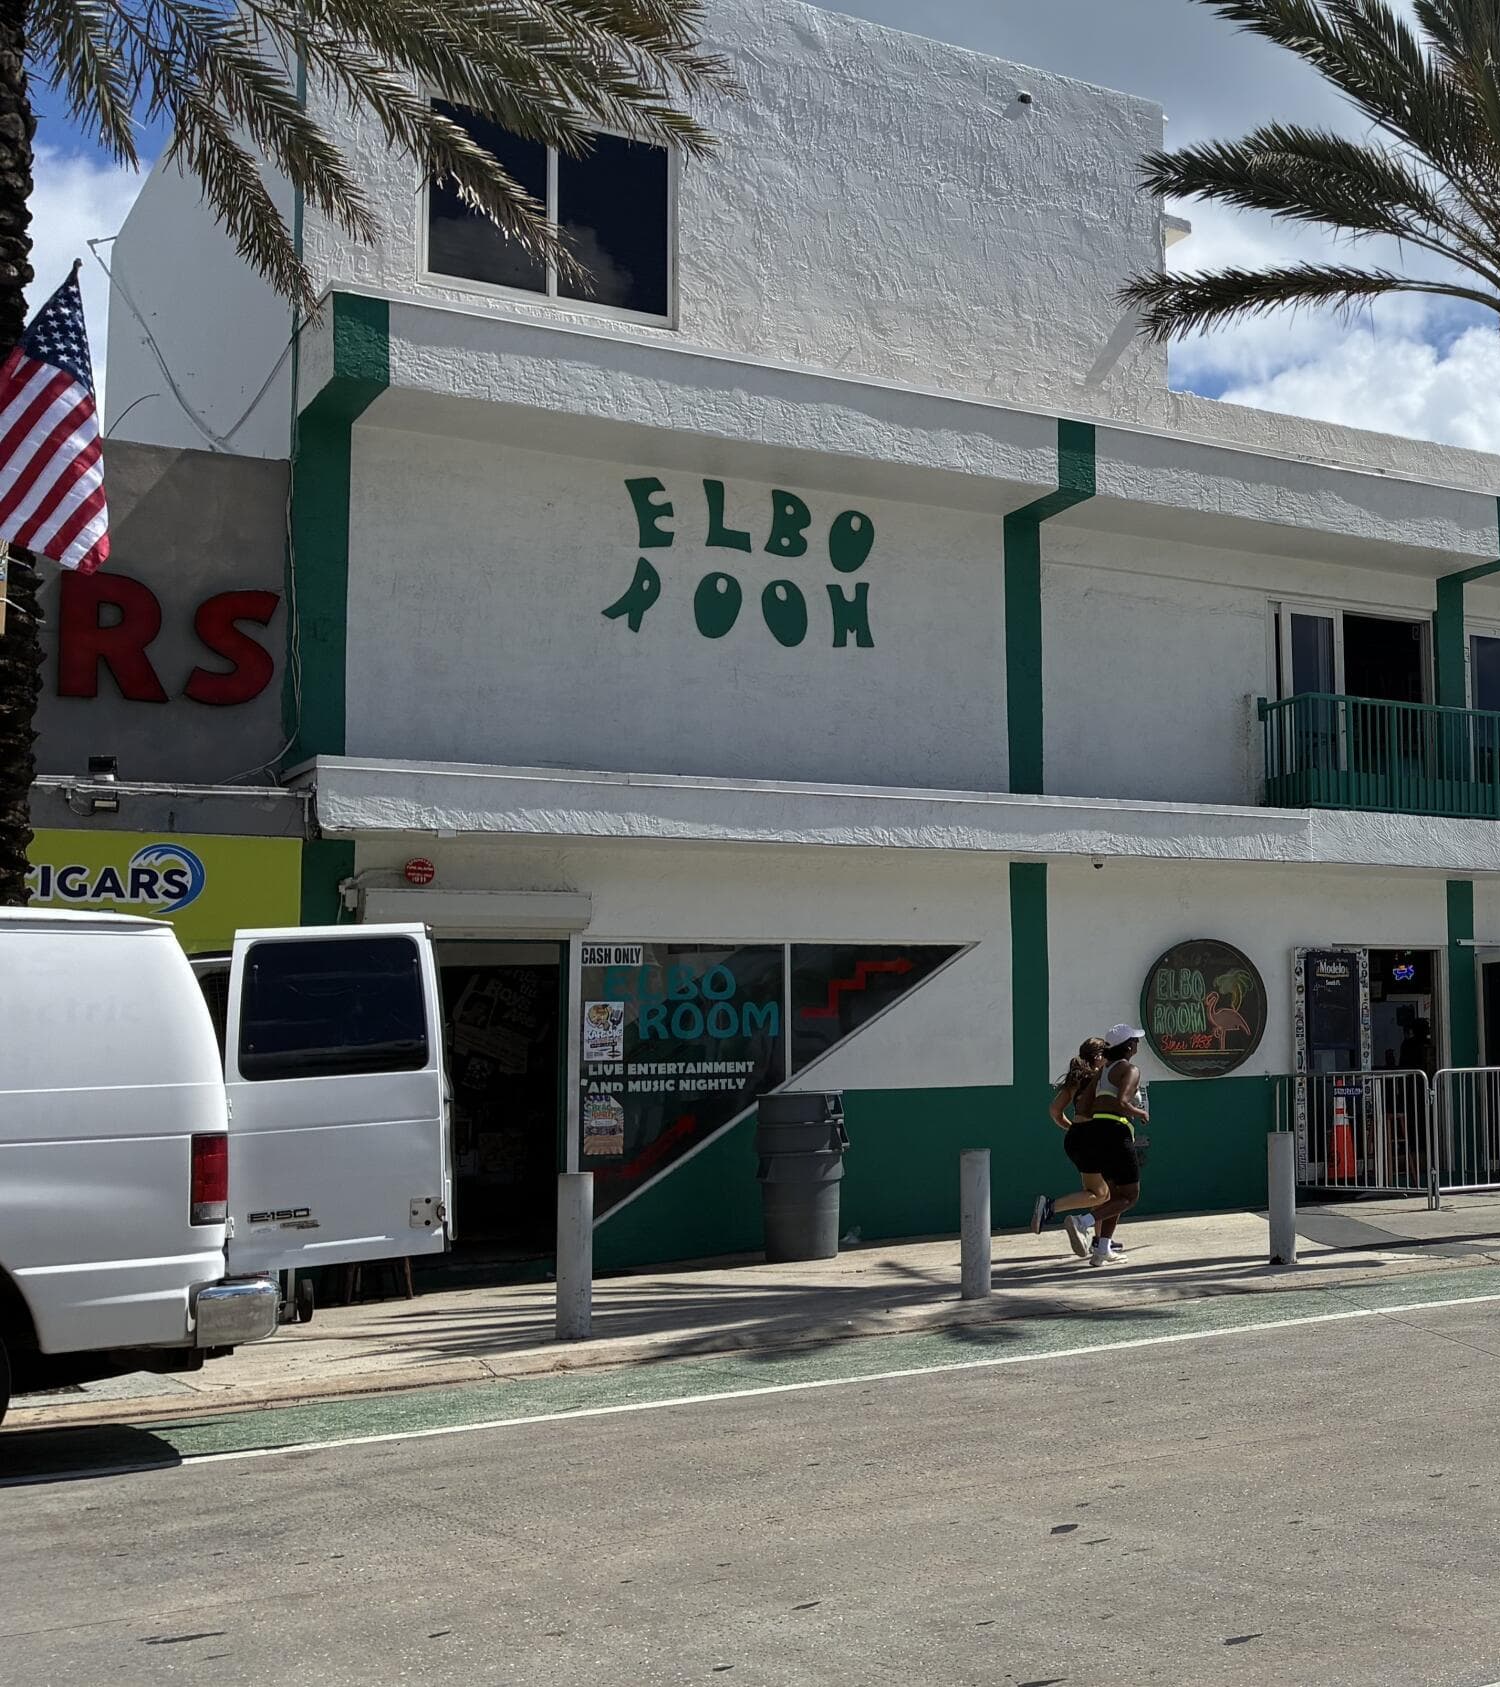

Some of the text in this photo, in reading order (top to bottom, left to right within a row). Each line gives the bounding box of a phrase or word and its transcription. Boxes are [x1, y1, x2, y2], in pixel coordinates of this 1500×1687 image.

[624, 477, 875, 574] ELBO
[601, 556, 875, 649] ROOM
[581, 948, 641, 965] CASH ONLY
[1319, 961, 1346, 974] Modelo
[604, 964, 737, 1001] ELBO
[1158, 968, 1205, 1001] ELBO
[639, 1001, 779, 1040] ROOM
[1153, 1002, 1206, 1035] ROOM
[588, 1061, 755, 1076] LIVE ENTERTAINMENT
[628, 1079, 675, 1092] MUSIC
[679, 1078, 746, 1091] NIGHTLY
